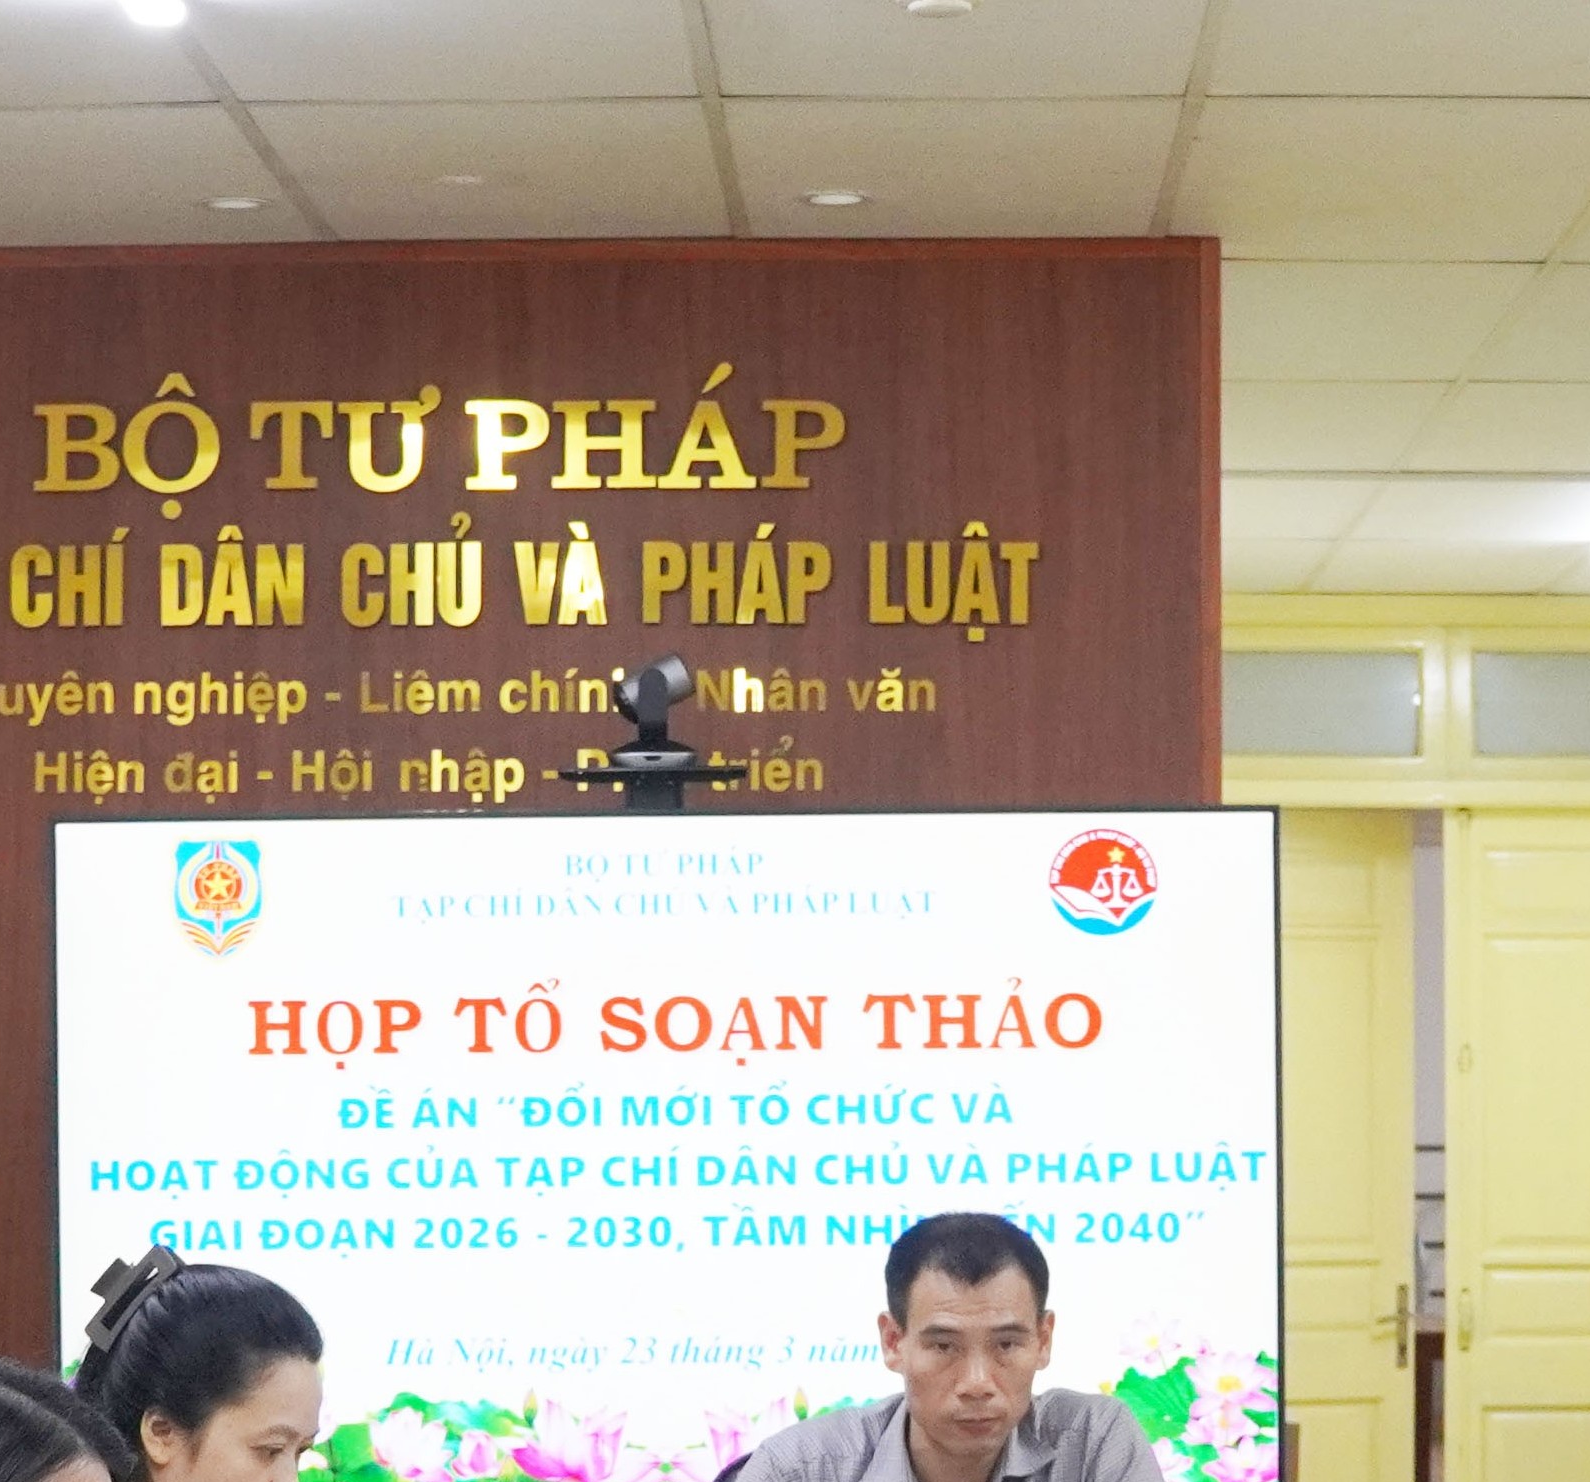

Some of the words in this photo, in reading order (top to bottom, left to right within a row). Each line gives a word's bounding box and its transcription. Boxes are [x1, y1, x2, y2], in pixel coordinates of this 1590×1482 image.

[34, 373, 221, 520] BỘ
[251, 384, 440, 493] TƯ
[465, 362, 846, 490] PHÁP
[11, 528, 130, 628] CHÍ
[161, 525, 307, 628] DÂN
[341, 512, 482, 627] CHỦ
[514, 522, 607, 625] VÀ
[642, 524, 831, 625] PHÁP
[868, 522, 1039, 642] LUẬT
[134, 671, 308, 726] nghiệp
[360, 669, 480, 715] Liêm
[499, 667, 625, 714] chín
[696, 667, 826, 714] Nhân
[847, 668, 937, 713] văn
[35, 752, 144, 804] Hiện
[165, 752, 239, 803] đại
[292, 750, 373, 801] Hội
[401, 750, 525, 802] nhập
[677, 845, 764, 877] PHÁP
[393, 895, 455, 925] TẠP
[752, 884, 839, 915] PHÁP
[248, 1000, 421, 1070] HỌP
[454, 978, 562, 1054] TỔ
[600, 994, 828, 1066] SOẠN
[863, 977, 1103, 1050] THẢO
[338, 1085, 394, 1129] ĐỀ
[412, 1088, 477, 1128] ÁN
[620, 1085, 712, 1127] MỚI
[729, 1080, 789, 1125] TỔ
[807, 1084, 936, 1125] CHỨC
[951, 1083, 1013, 1123] VÀ
[90, 1160, 218, 1199] HOẠT
[234, 1149, 370, 1198] ĐỘNG
[387, 1144, 479, 1188] CỦA
[495, 1156, 585, 1196] TẠP
[602, 1146, 678, 1187] CHÍ
[697, 1145, 797, 1186] DÂN
[814, 1142, 909, 1185] CHỦ
[928, 1144, 988, 1184] VÀ
[1008, 1143, 1133, 1184] PHÁP
[1150, 1141, 1266, 1190] LUẬT
[149, 1219, 243, 1251] GIAI
[259, 1218, 395, 1257] ĐOẠN
[414, 1217, 519, 1248] 2026
[566, 1215, 685, 1253] 2030,
[703, 1203, 806, 1247] TẦM
[825, 1203, 928, 1246] NHÌ
[385, 1337, 435, 1367] Hà
[449, 1336, 514, 1372] Nội,
[527, 1339, 609, 1372] ngày
[620, 1336, 659, 1366] 23
[669, 1335, 766, 1371] tháng
[776, 1335, 797, 1365] 3
[807, 1338, 881, 1365] năm
